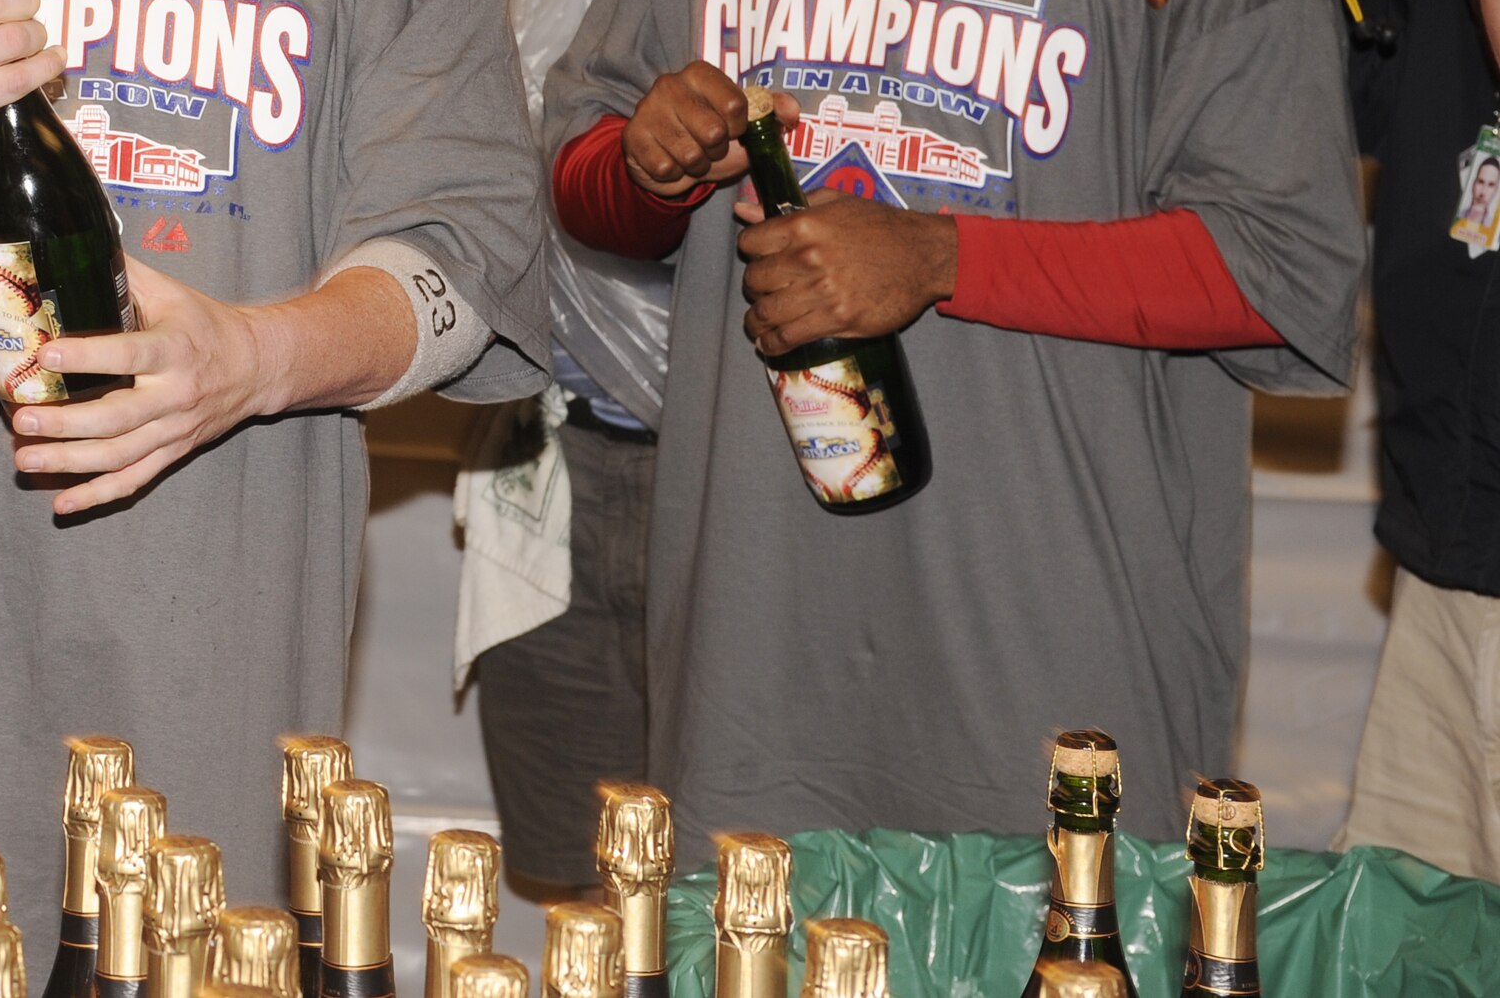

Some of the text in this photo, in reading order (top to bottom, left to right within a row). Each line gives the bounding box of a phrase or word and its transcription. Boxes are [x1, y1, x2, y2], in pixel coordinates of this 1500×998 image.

[77, 77, 208, 120] ROW
[754, 67, 990, 126] 4 IN A ROW
[412, 268, 456, 337] 23
